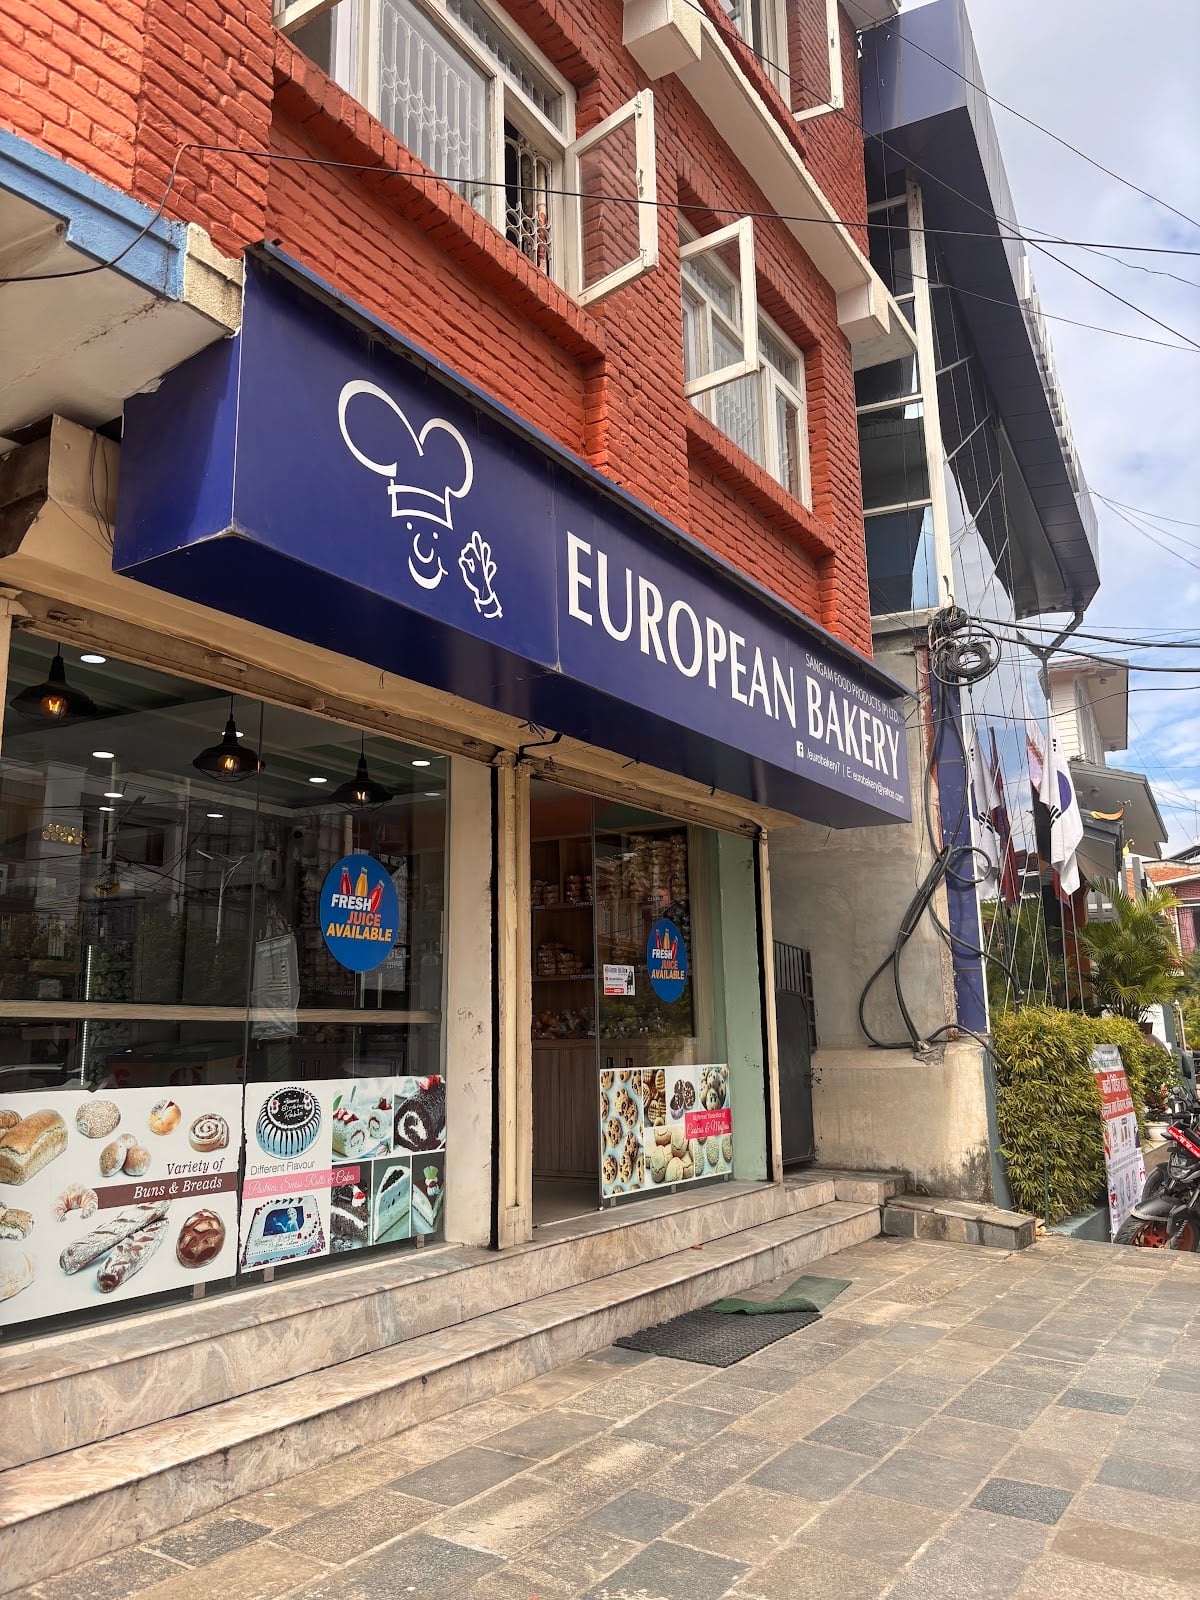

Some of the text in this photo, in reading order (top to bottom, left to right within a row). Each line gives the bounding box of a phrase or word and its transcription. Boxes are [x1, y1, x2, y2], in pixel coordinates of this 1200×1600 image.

[567, 531, 900, 781] EUROPEAN BAKERY
[805, 653, 834, 681] SANGAM
[834, 672, 851, 692] FOOD
[852, 683, 882, 712] PRODUCTS
[331, 893, 372, 911] FRESH
[347, 911, 382, 927] JUICE
[326, 922, 393, 942] AVAILABLE
[652, 949, 673, 959] FRESH
[661, 960, 679, 970] JUICE
[651, 969, 685, 980] AVAILABLE
[167, 1157, 226, 1176] Variety of
[250, 1160, 316, 1176] Different Flavour
[133, 1176, 223, 1200] Buns & Breads
